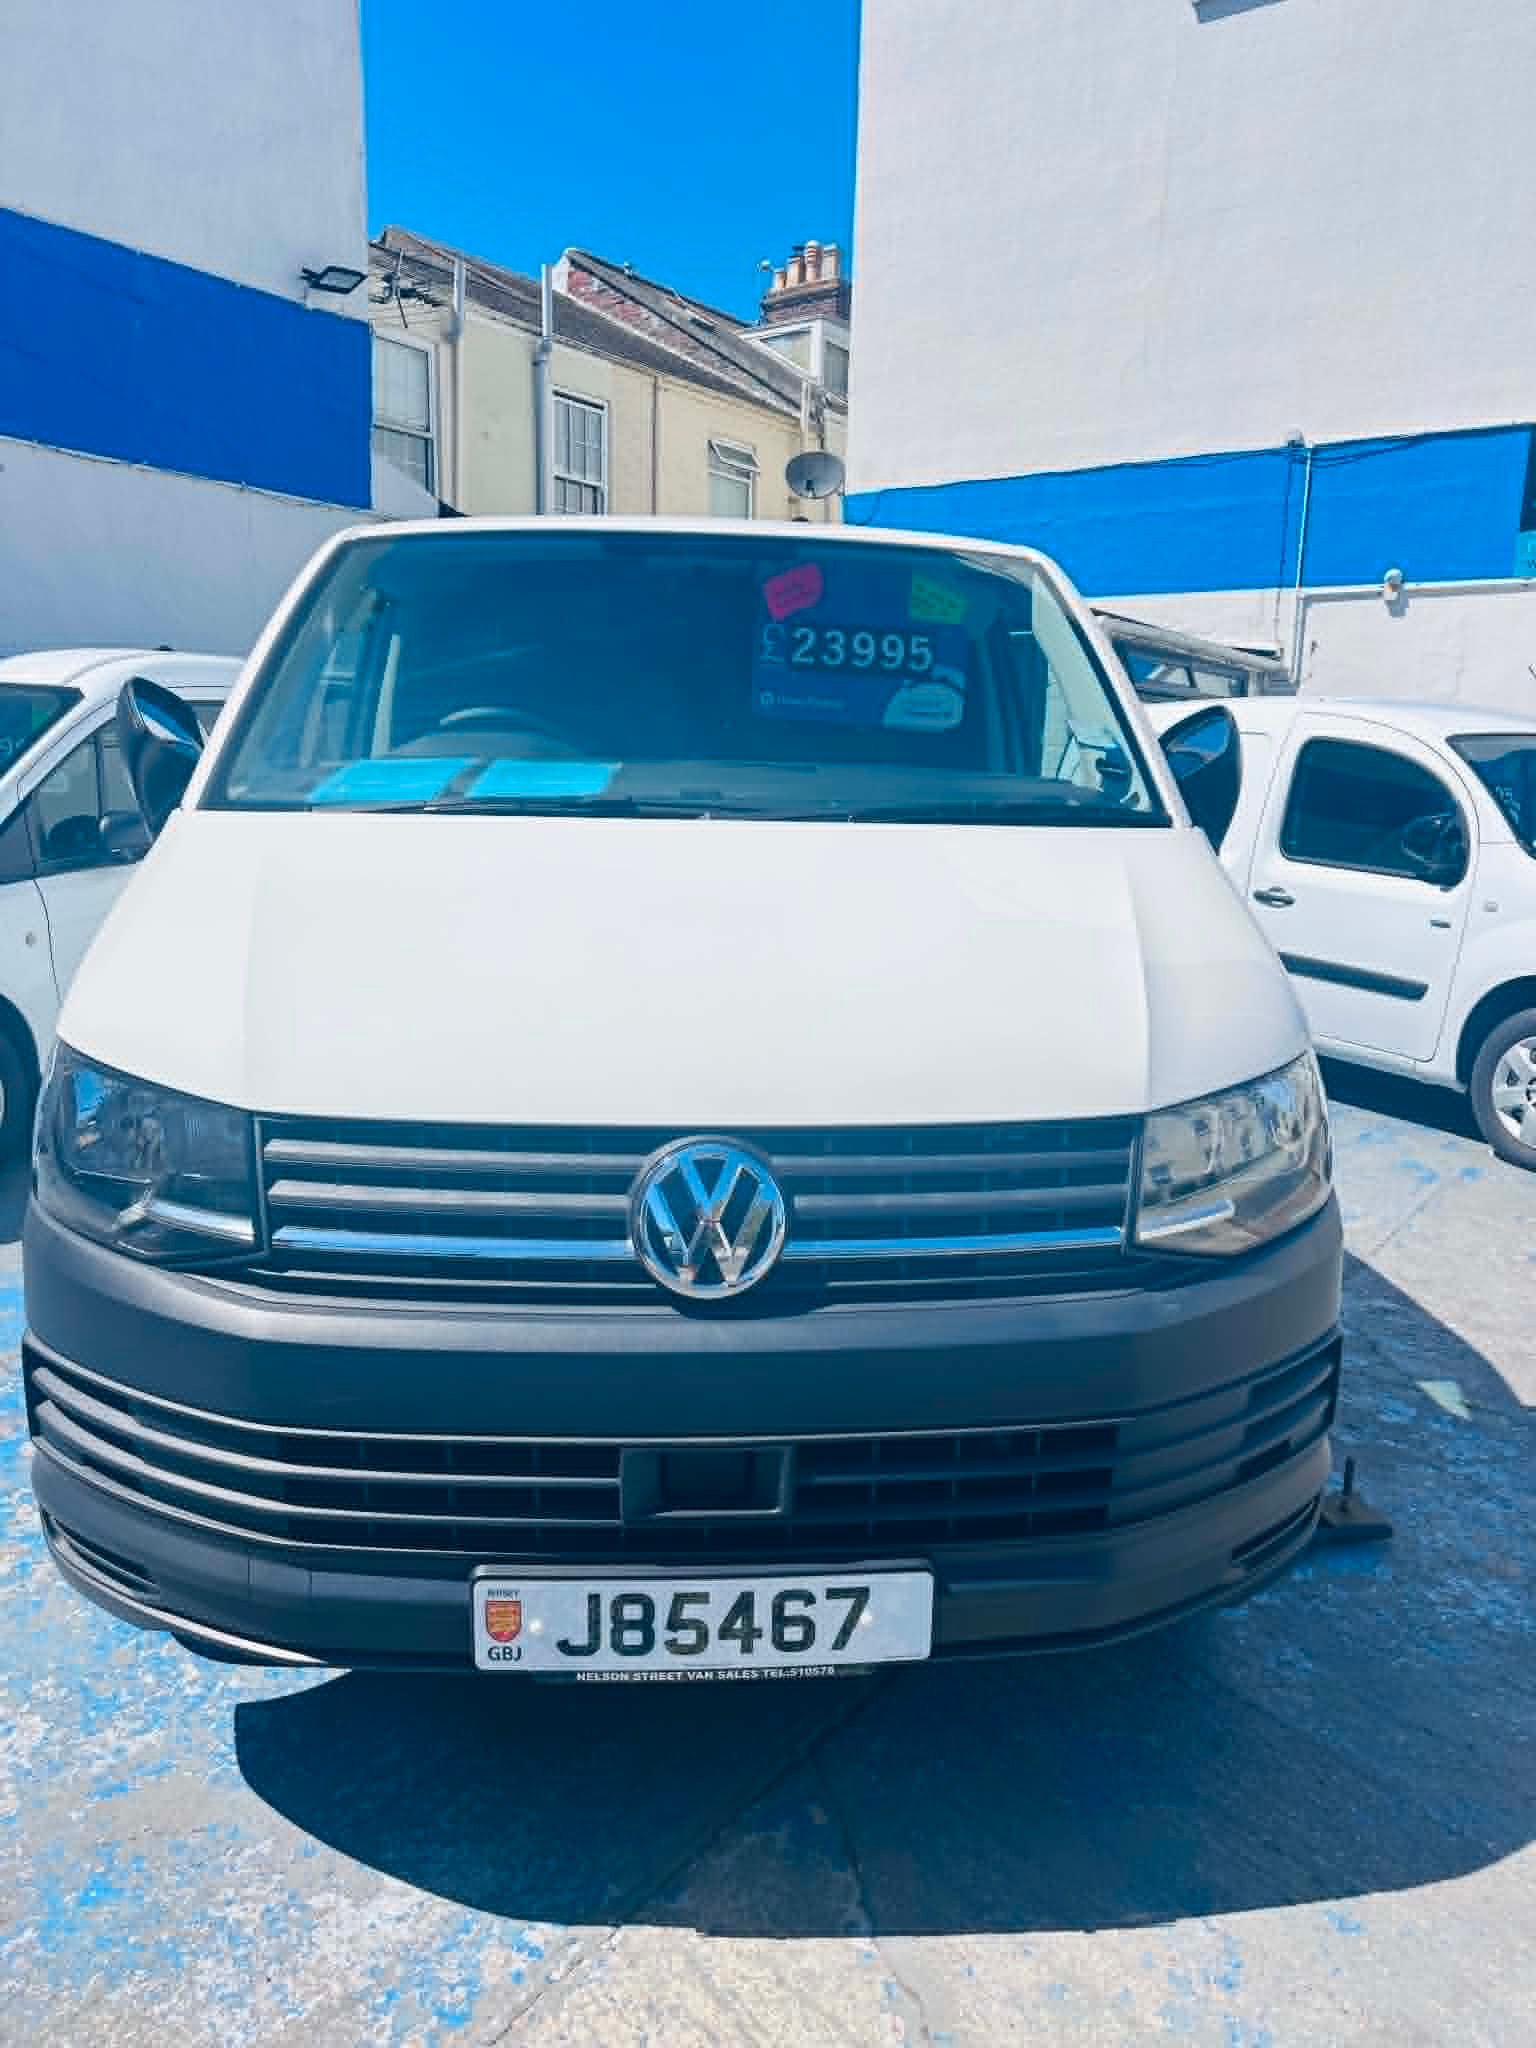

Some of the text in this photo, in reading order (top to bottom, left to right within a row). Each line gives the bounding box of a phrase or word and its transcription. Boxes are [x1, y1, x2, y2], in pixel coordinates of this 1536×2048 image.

[555, 1586, 871, 1657] J85467
[487, 1646, 522, 1662] GBJ
[576, 1671, 629, 1681] NELSON
[631, 1671, 681, 1681] STREET
[687, 1671, 714, 1681] VAN
[719, 1670, 760, 1680] SALES
